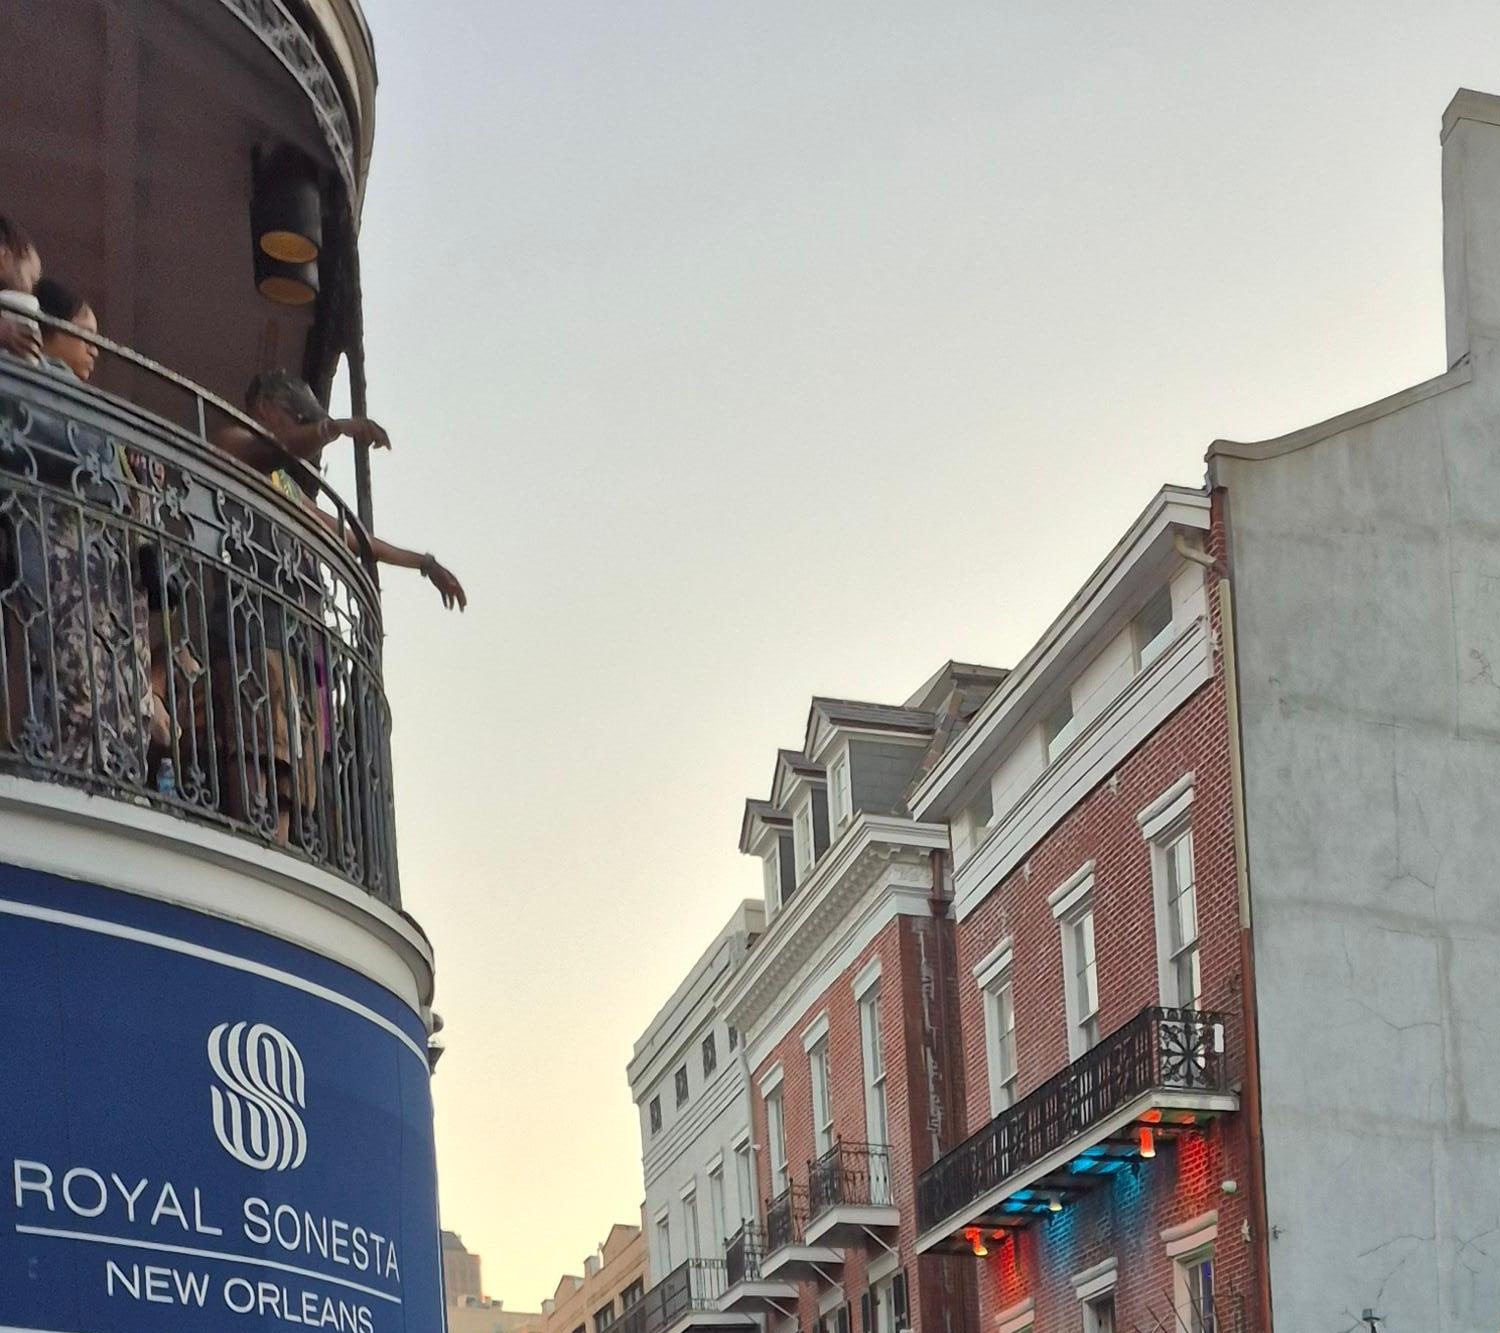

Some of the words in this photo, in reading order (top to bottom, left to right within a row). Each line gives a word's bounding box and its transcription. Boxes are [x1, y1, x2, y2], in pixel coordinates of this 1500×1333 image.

[14, 1159, 223, 1236] ROYAL
[243, 1197, 401, 1283] SONESTA
[106, 1260, 210, 1307] NEW
